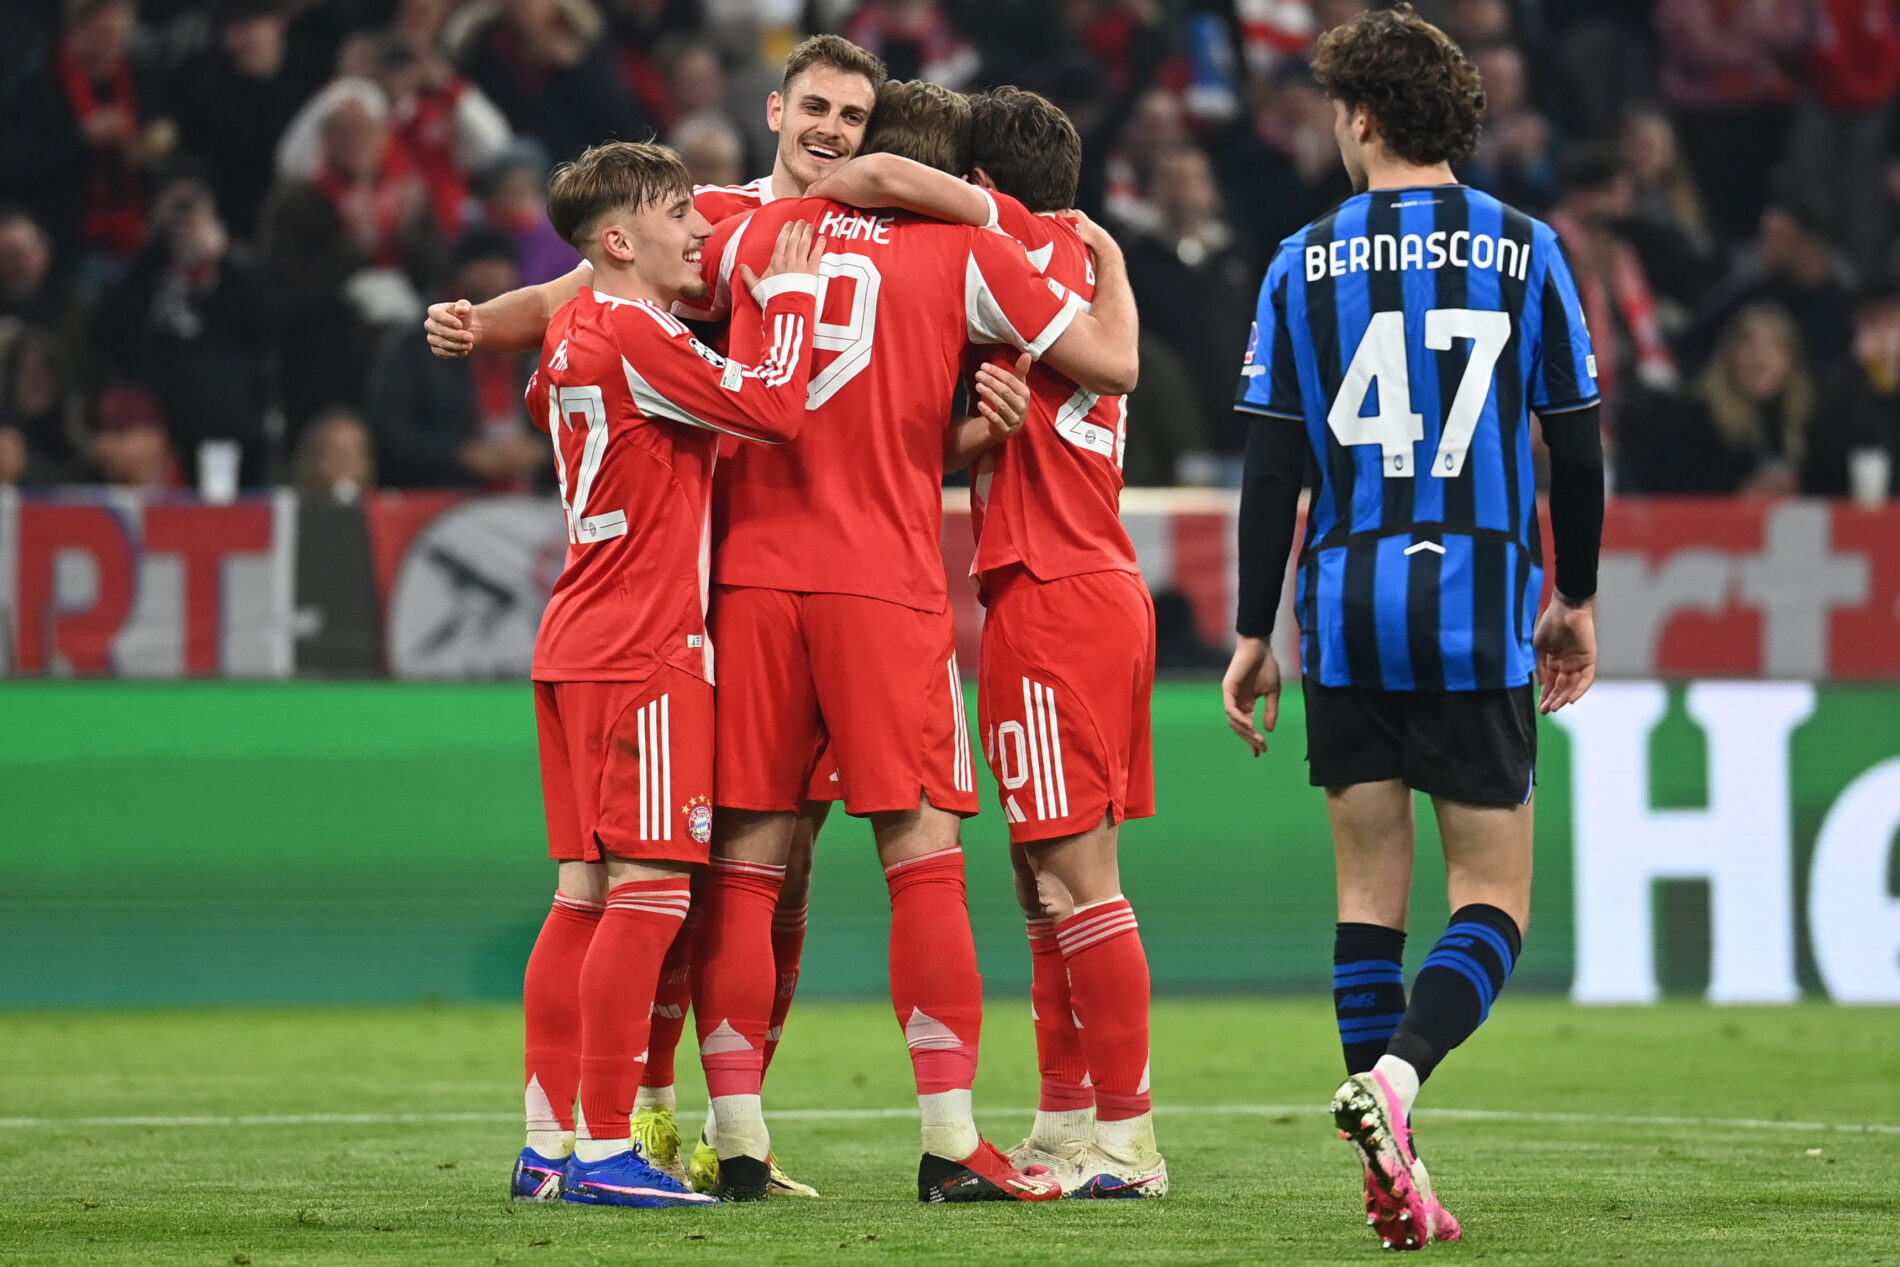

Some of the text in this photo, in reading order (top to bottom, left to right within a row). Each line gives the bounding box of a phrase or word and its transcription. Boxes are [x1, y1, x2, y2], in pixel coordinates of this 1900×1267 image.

[818, 211, 894, 244] KANE
[1306, 231, 1530, 281] BERNASCONI
[805, 252, 882, 411] 9
[1327, 308, 1512, 478] 47
